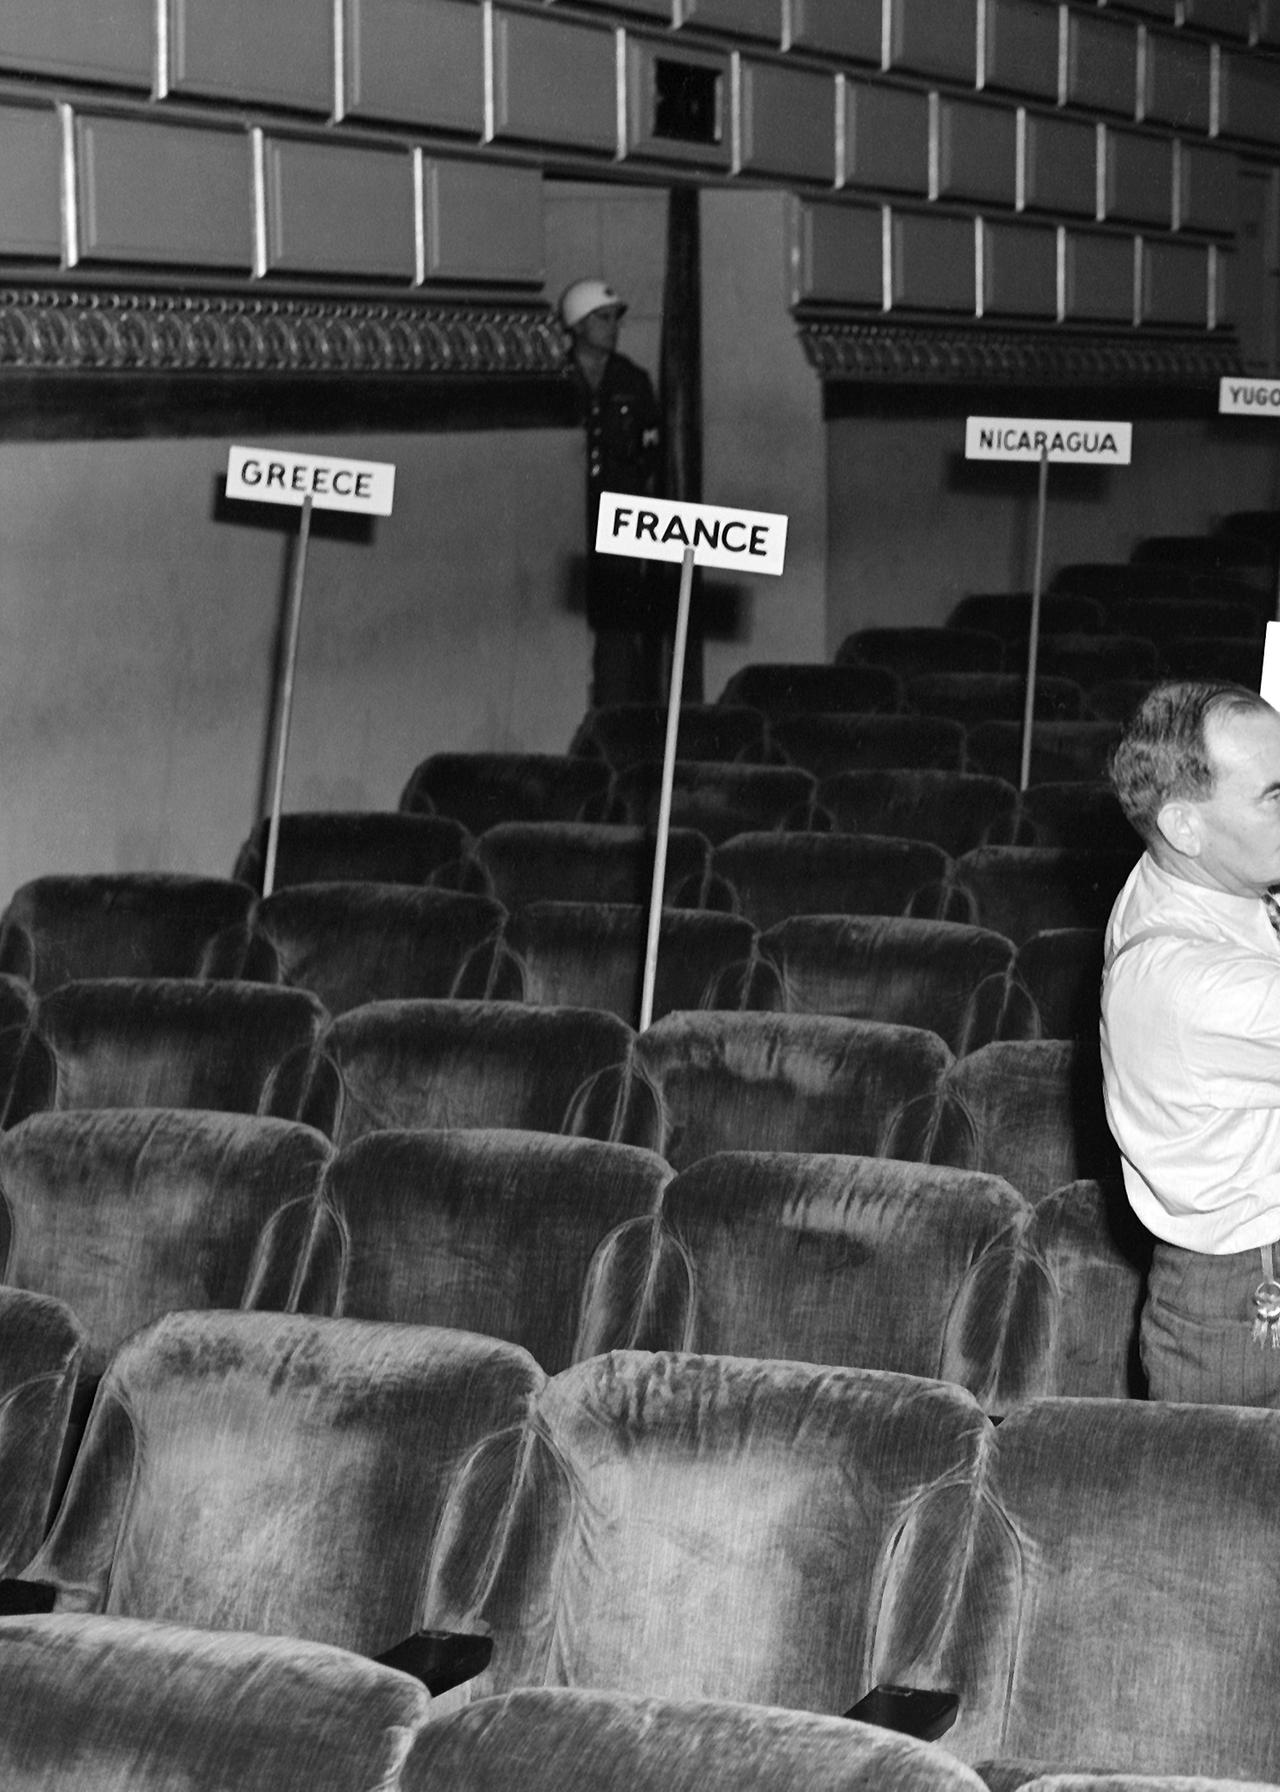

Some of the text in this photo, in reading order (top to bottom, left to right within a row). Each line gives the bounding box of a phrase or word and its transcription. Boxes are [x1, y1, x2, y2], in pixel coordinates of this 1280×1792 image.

[979, 430, 1117, 453] NICARAGUA
[241, 460, 373, 498] GREECE
[612, 507, 770, 557] FRANCE
